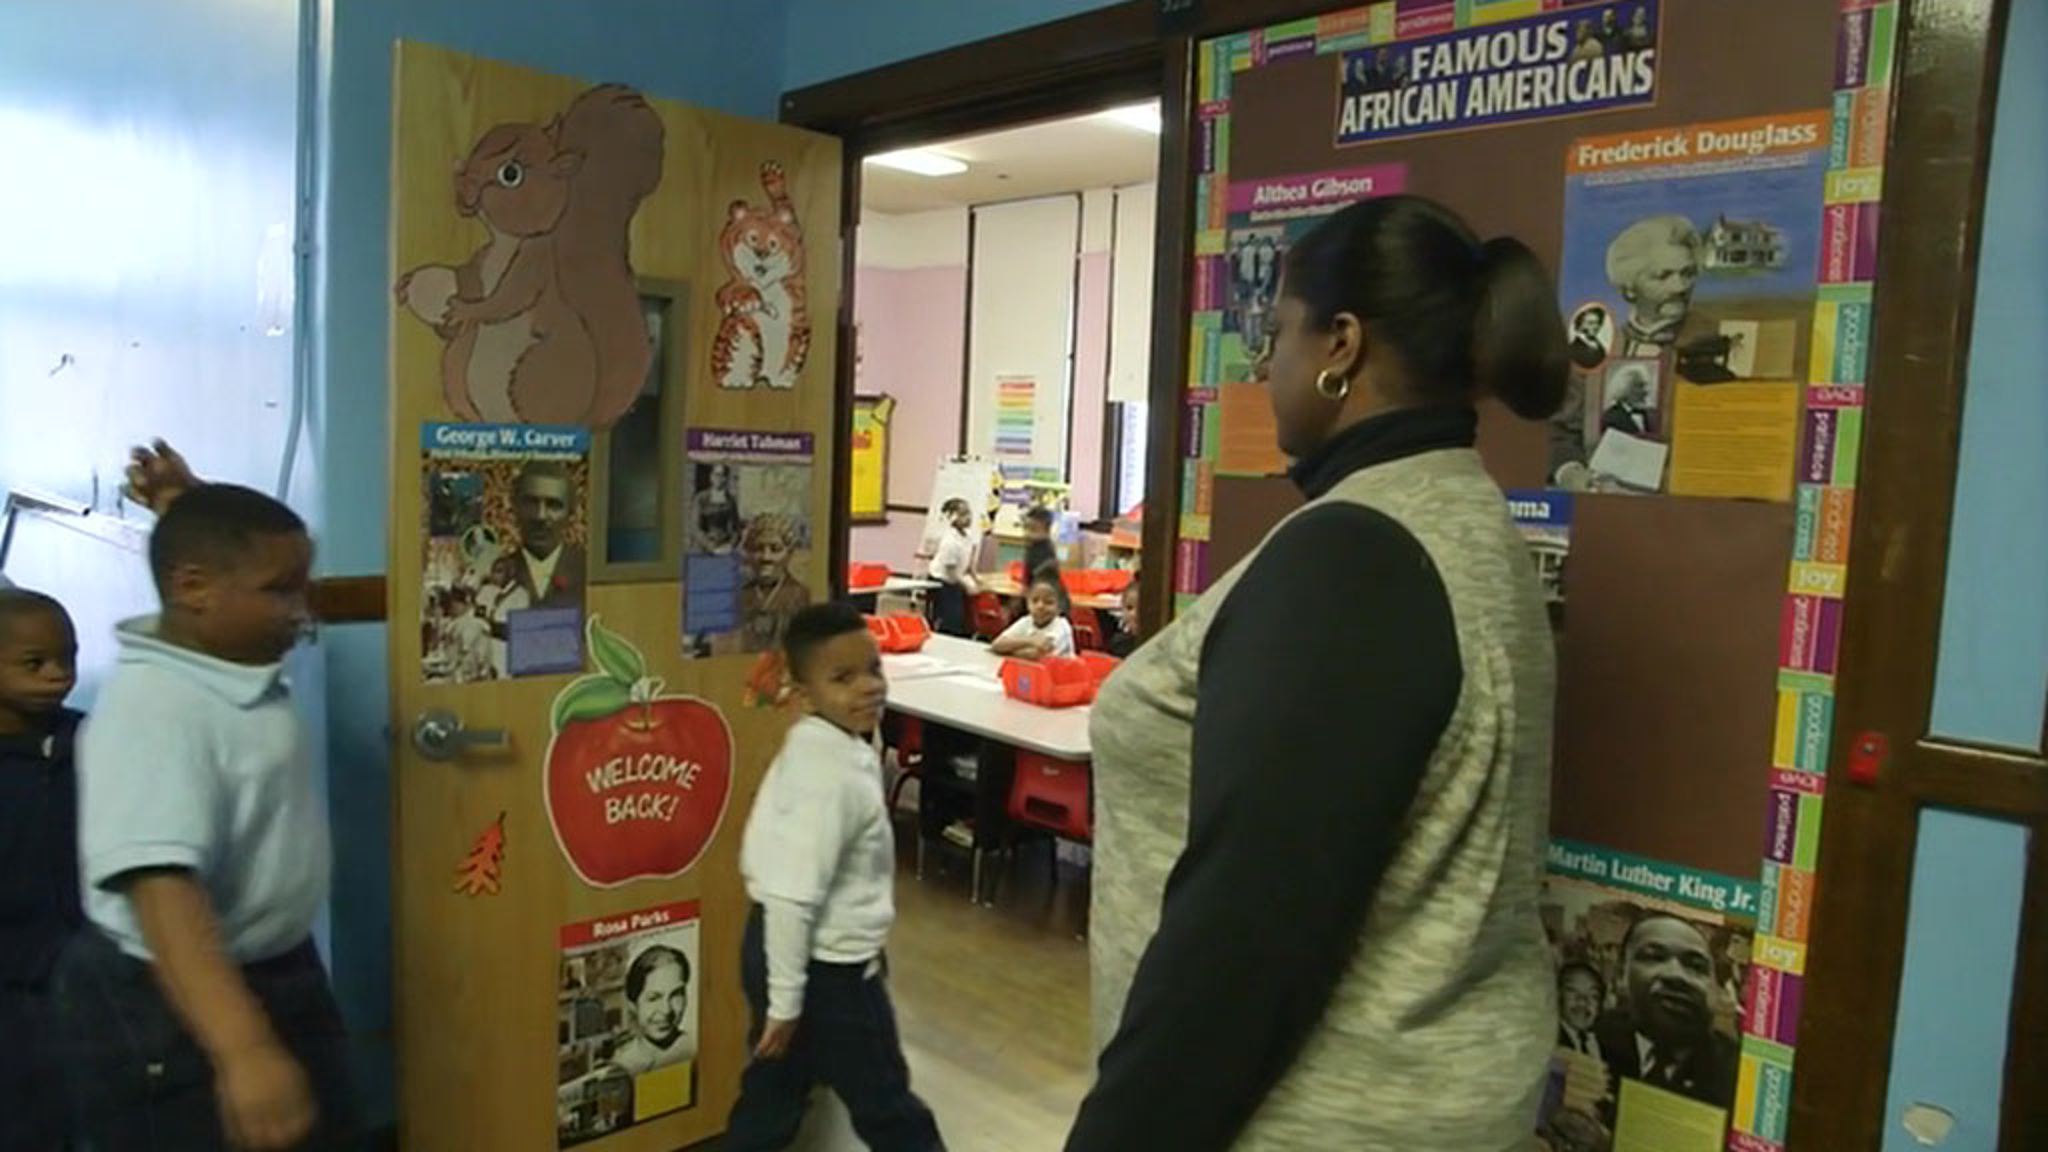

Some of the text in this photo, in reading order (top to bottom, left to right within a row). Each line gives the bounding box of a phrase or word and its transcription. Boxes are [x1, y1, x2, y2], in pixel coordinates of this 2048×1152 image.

[1411, 21, 1567, 82] FAMOUS
[1339, 49, 1655, 135] AFRICAN AMERICANS
[1578, 124, 1817, 166] Frederick Douglass
[1254, 177, 1373, 205] Althea Gibson
[436, 426, 577, 449] George W. Carver
[702, 432, 748, 448] Harriet
[1810, 411, 1829, 481] patience
[586, 753, 703, 793] WELCOME
[605, 792, 680, 825] BACK!
[1773, 793, 1791, 859] patience
[1550, 845, 1607, 877] Martin
[1611, 858, 1674, 892] Luther
[1679, 874, 1727, 909] King
[1730, 885, 1757, 913] Jr.
[593, 911, 670, 938] Rosa Parks
